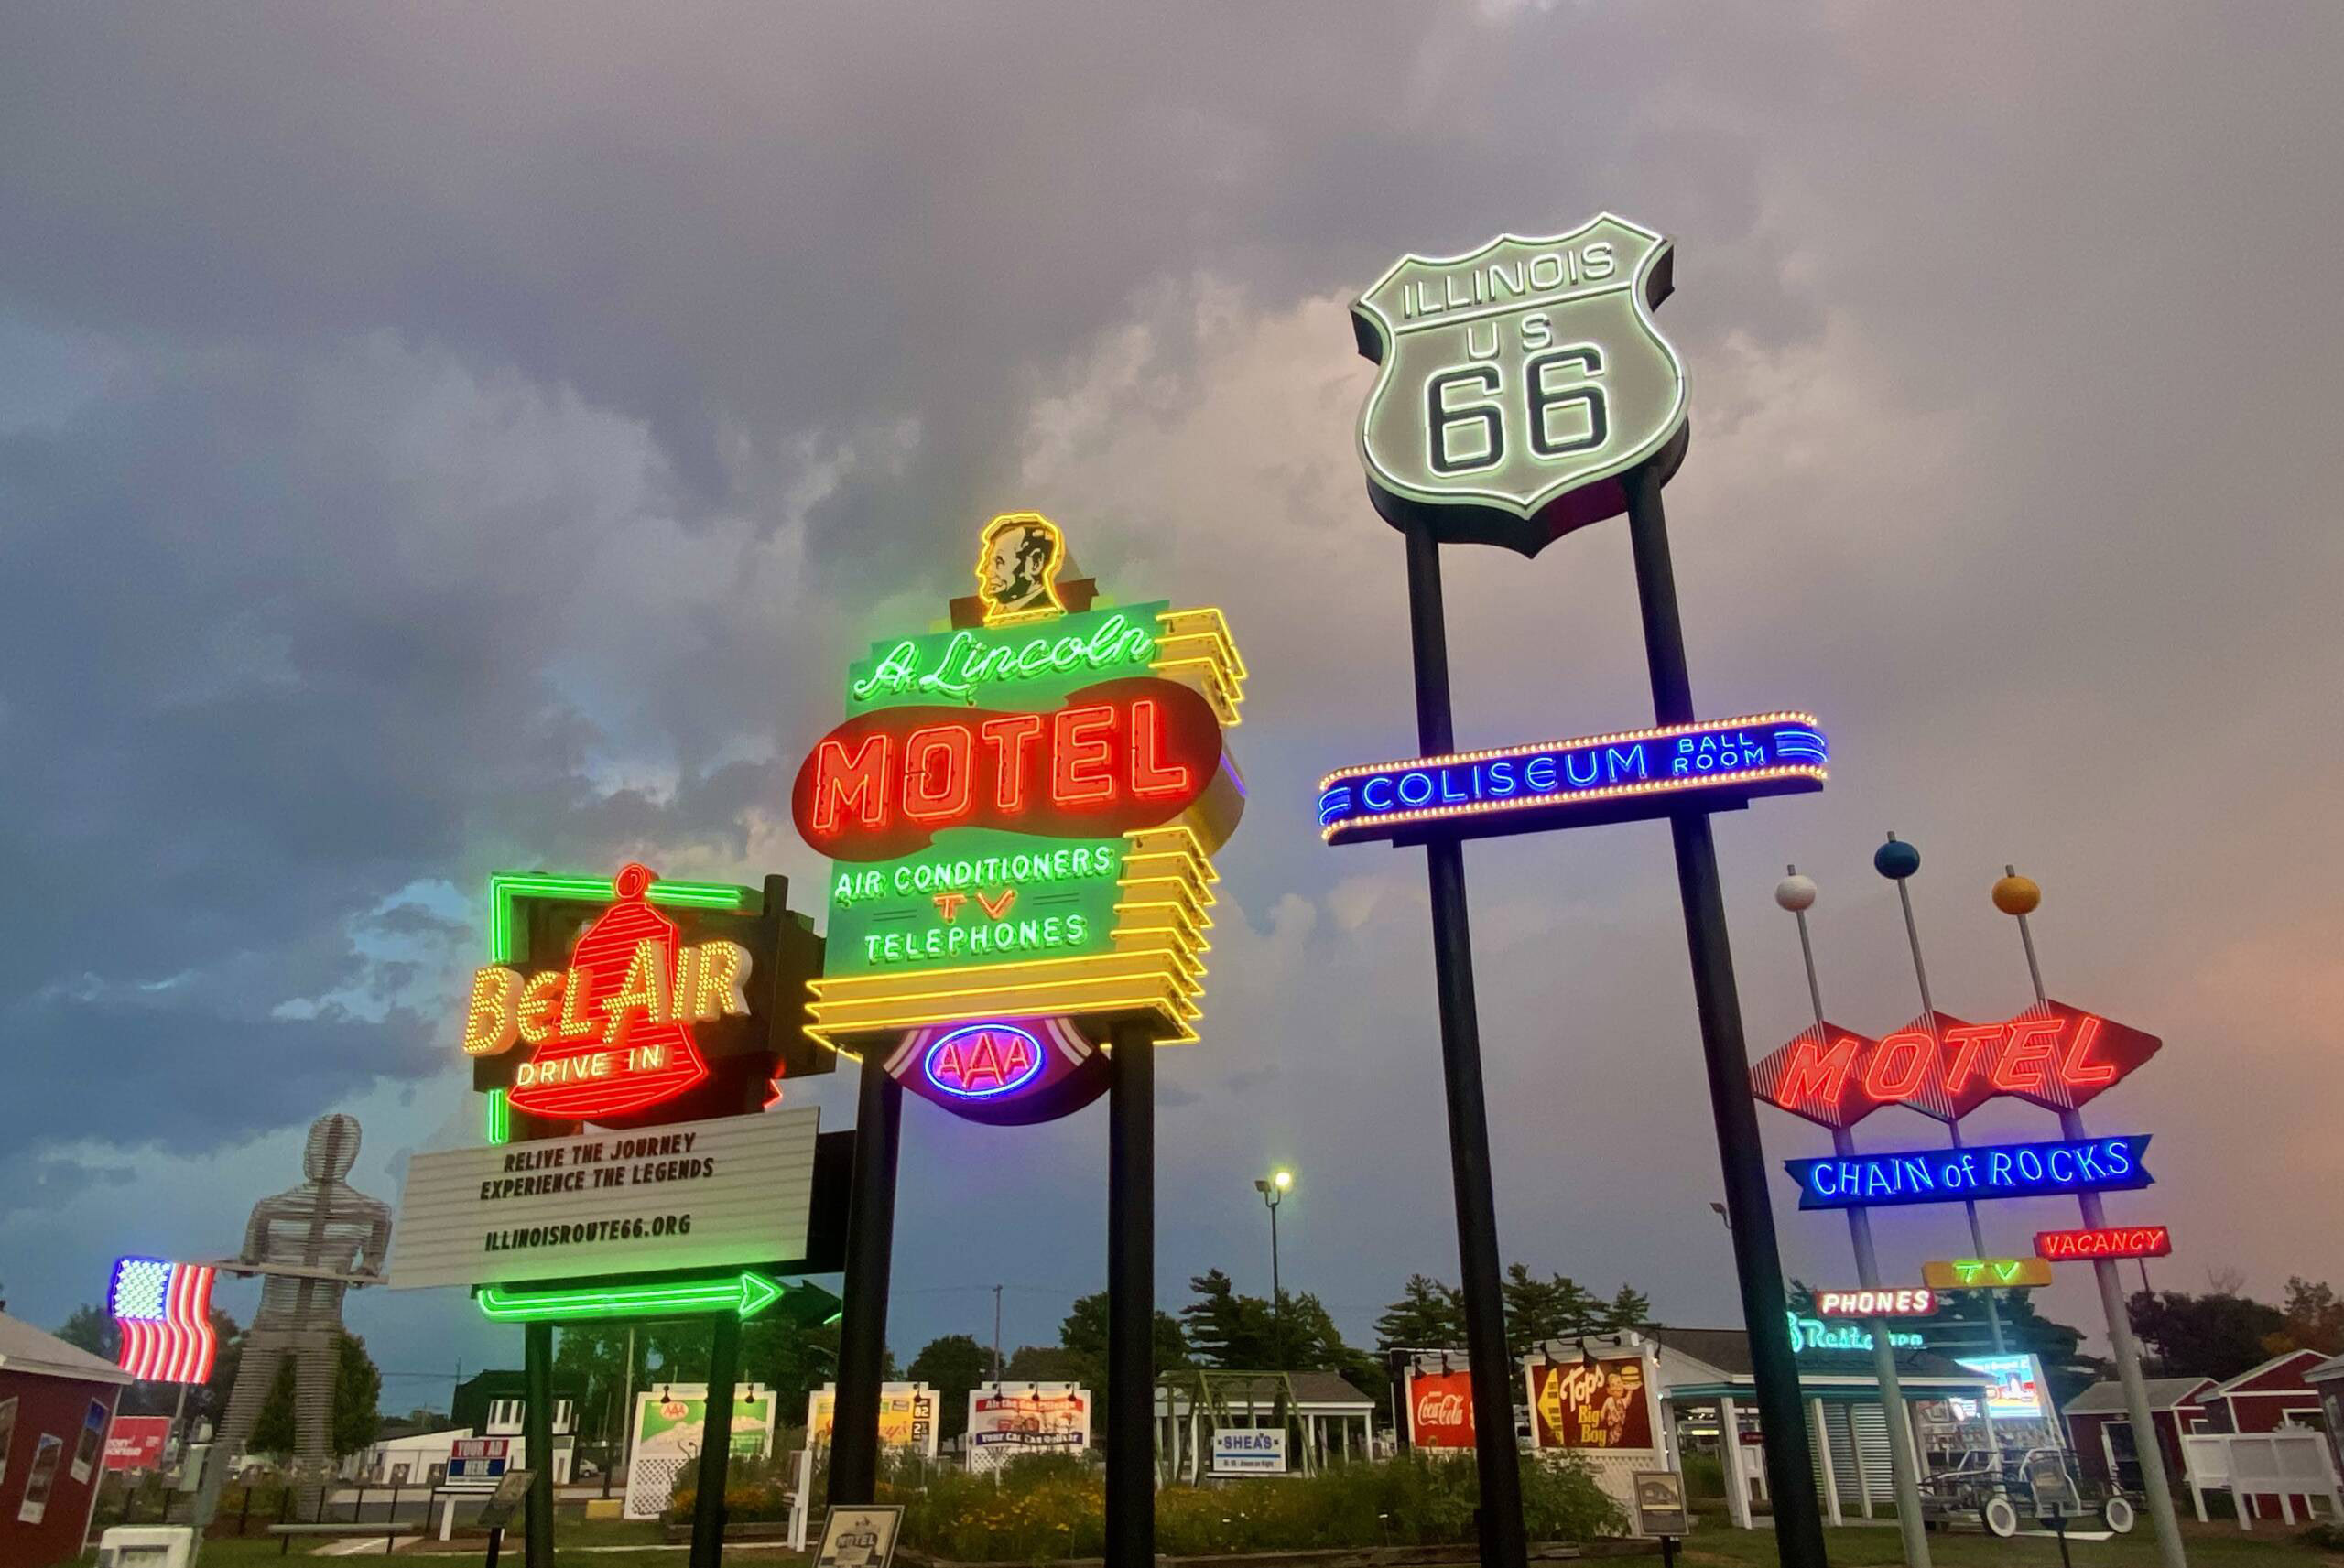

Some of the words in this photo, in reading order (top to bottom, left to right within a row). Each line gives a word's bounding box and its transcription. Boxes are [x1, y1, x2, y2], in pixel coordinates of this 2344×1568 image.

[1403, 243, 1616, 318] ILLINOIS
[1424, 342, 1610, 478] 66
[918, 614, 1155, 694] Lincoln
[812, 699, 1188, 829] MOTEL
[1673, 748, 1765, 774] ROOM
[1678, 733, 1754, 754] BALL
[1362, 742, 1648, 810] COLISEUM
[835, 875, 880, 899] AIR
[894, 846, 1115, 890] CONDITIONERS
[934, 890, 1018, 924] TV
[865, 915, 1087, 962] TELEPHONES
[601, 938, 753, 1044] AIR
[516, 1052, 608, 1087] DRIVE
[627, 1044, 665, 1072] IN
[935, 1032, 1034, 1088] AAA
[1778, 1016, 2115, 1109] MOTEL
[504, 1148, 564, 1173] RELIVE
[573, 1142, 604, 1164] THE
[610, 1132, 696, 1161] JOURNEY
[1813, 1157, 1934, 1195] CHAIN
[1945, 1155, 1976, 1189] of
[1991, 1142, 2132, 1185] ROCKS
[480, 1172, 584, 1200] EXPERIENCE
[594, 1165, 626, 1187] THE
[632, 1157, 715, 1184] LEGENDS
[484, 1214, 691, 1252] ILLINOISROUTE66.ORG
[2045, 1230, 2165, 1254] VACANCY
[1952, 1262, 2022, 1283] TV
[1822, 1290, 1930, 1314] PHONES
[1560, 1364, 1605, 1412] Tops
[1578, 1404, 1601, 1428] Big
[1581, 1424, 1607, 1448] Boy
[1223, 1433, 1273, 1450] SHEA'S
